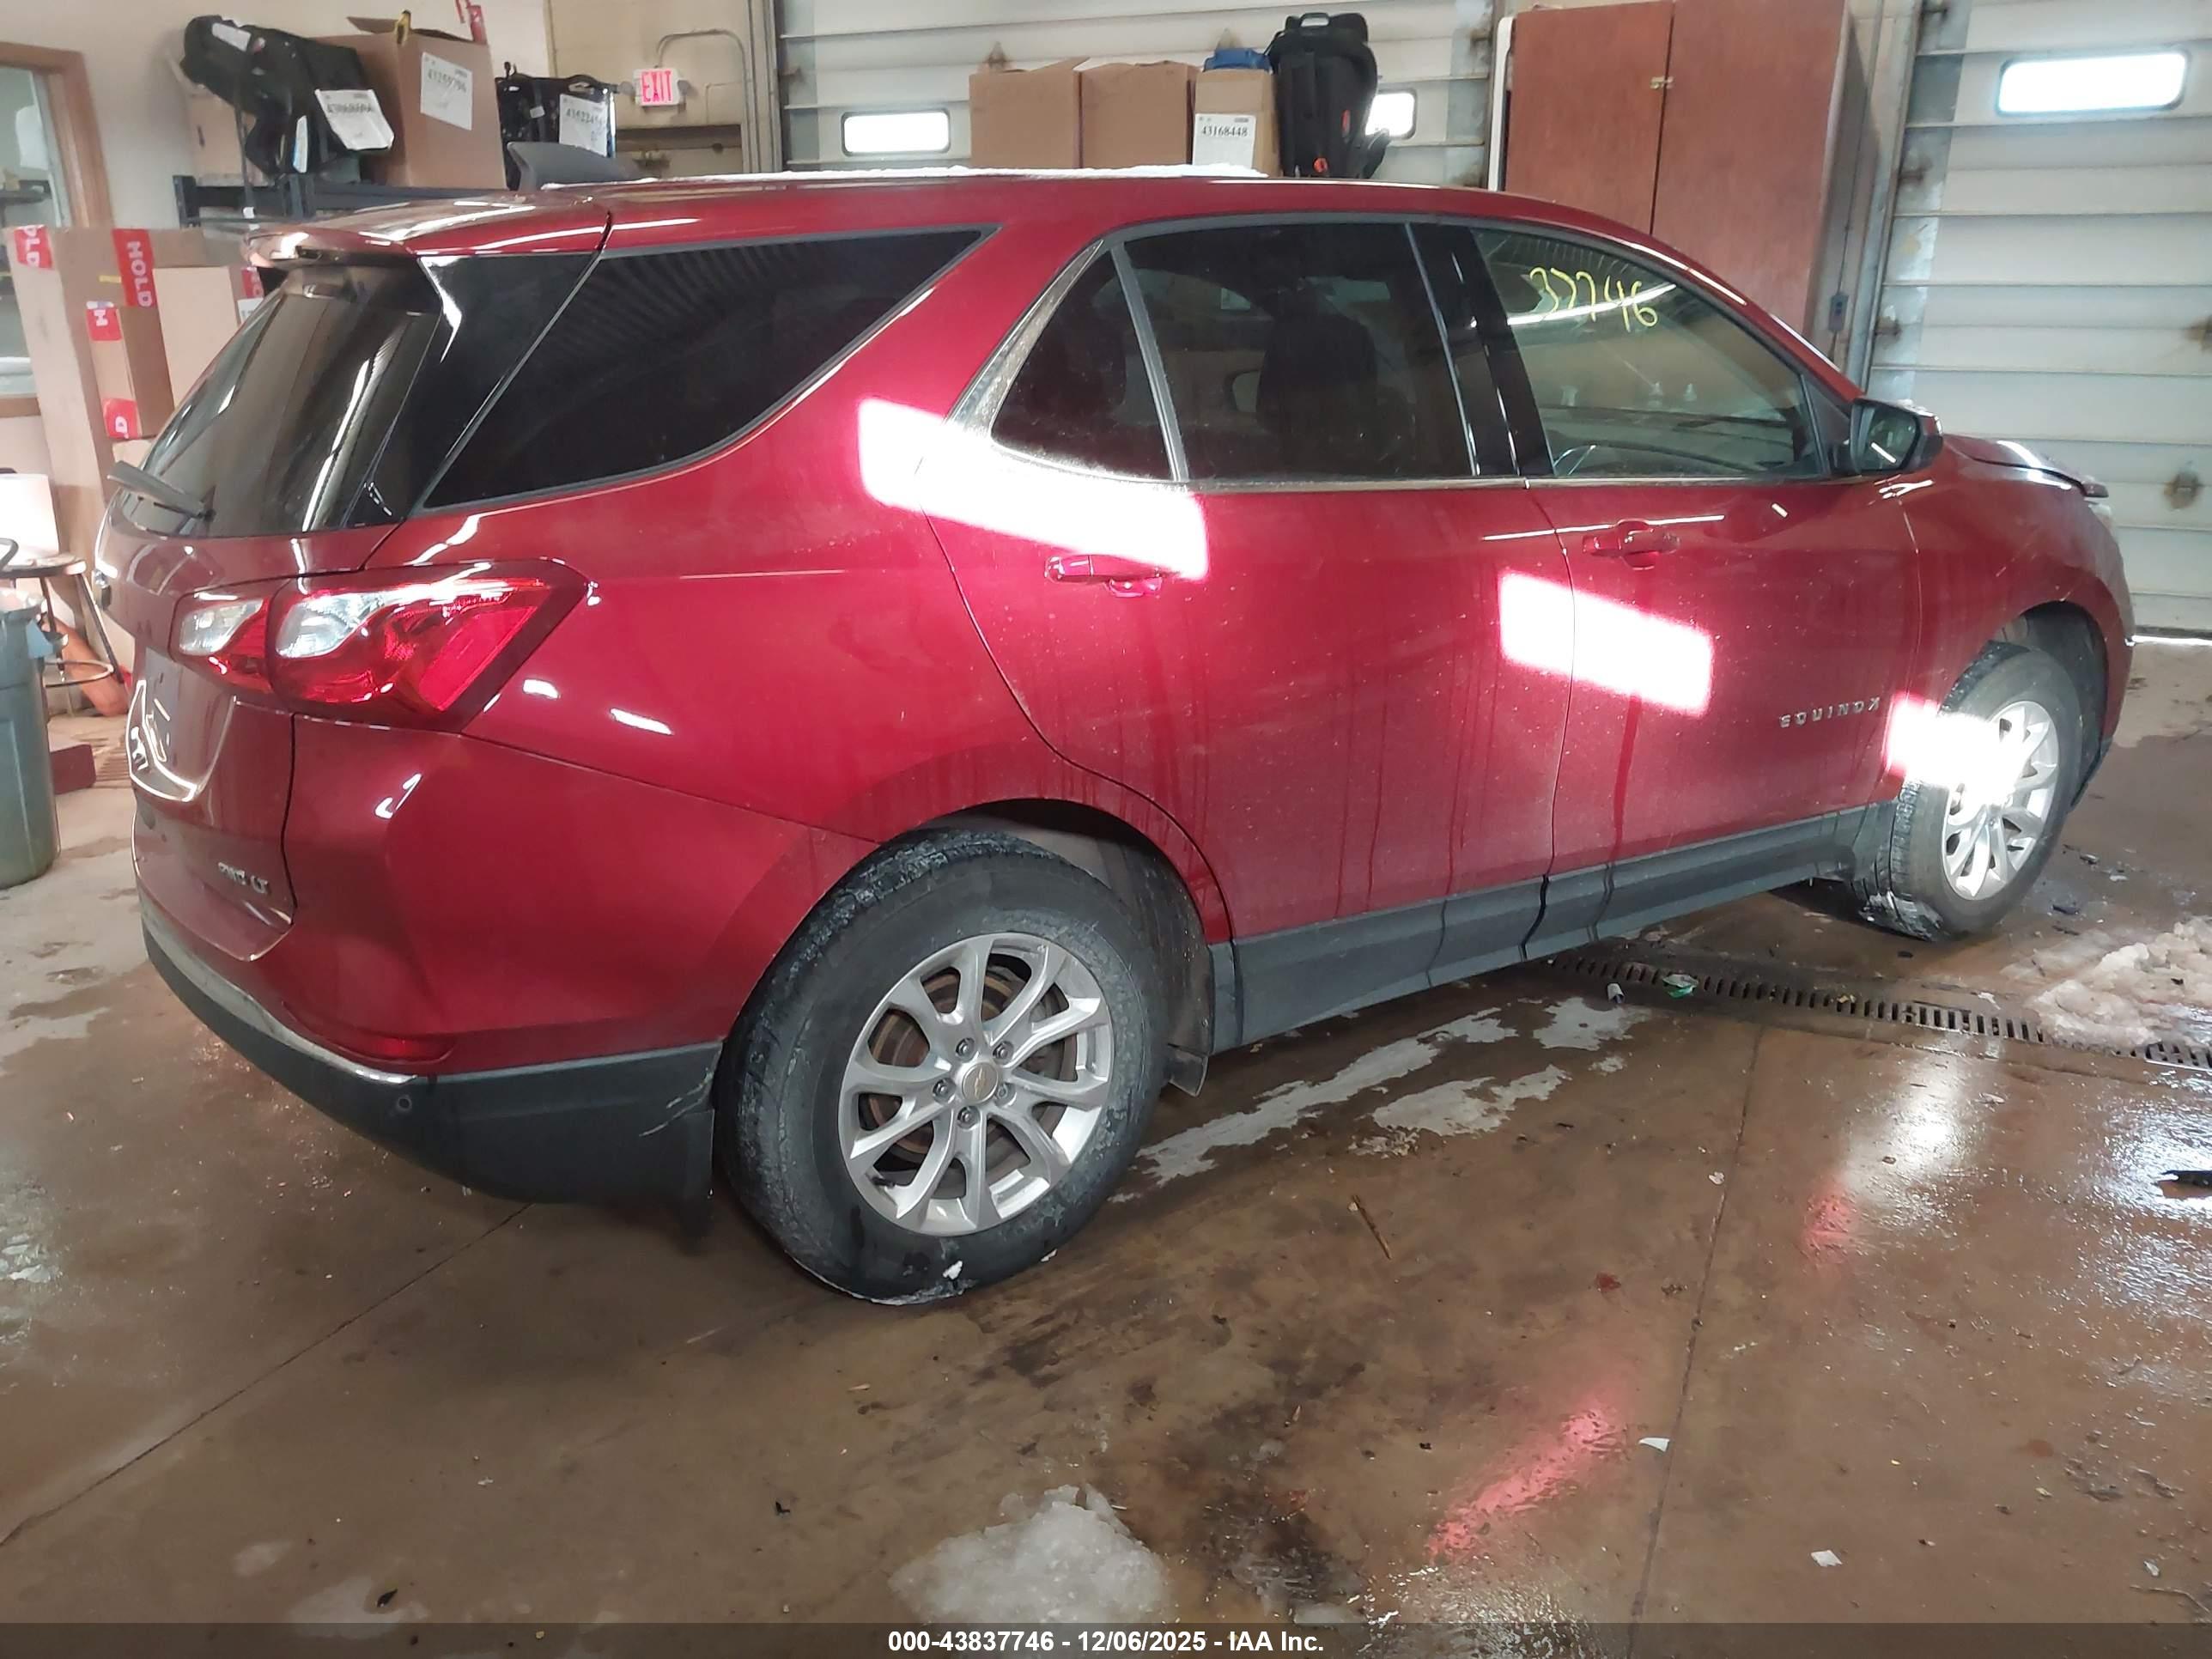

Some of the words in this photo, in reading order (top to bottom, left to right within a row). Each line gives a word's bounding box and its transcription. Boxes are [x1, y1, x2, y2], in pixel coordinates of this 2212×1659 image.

[641, 70, 672, 101] EXIT
[1202, 126, 1249, 137] 43168448
[126, 240, 152, 307] HOLD
[1778, 696, 1881, 728] EQUINOX
